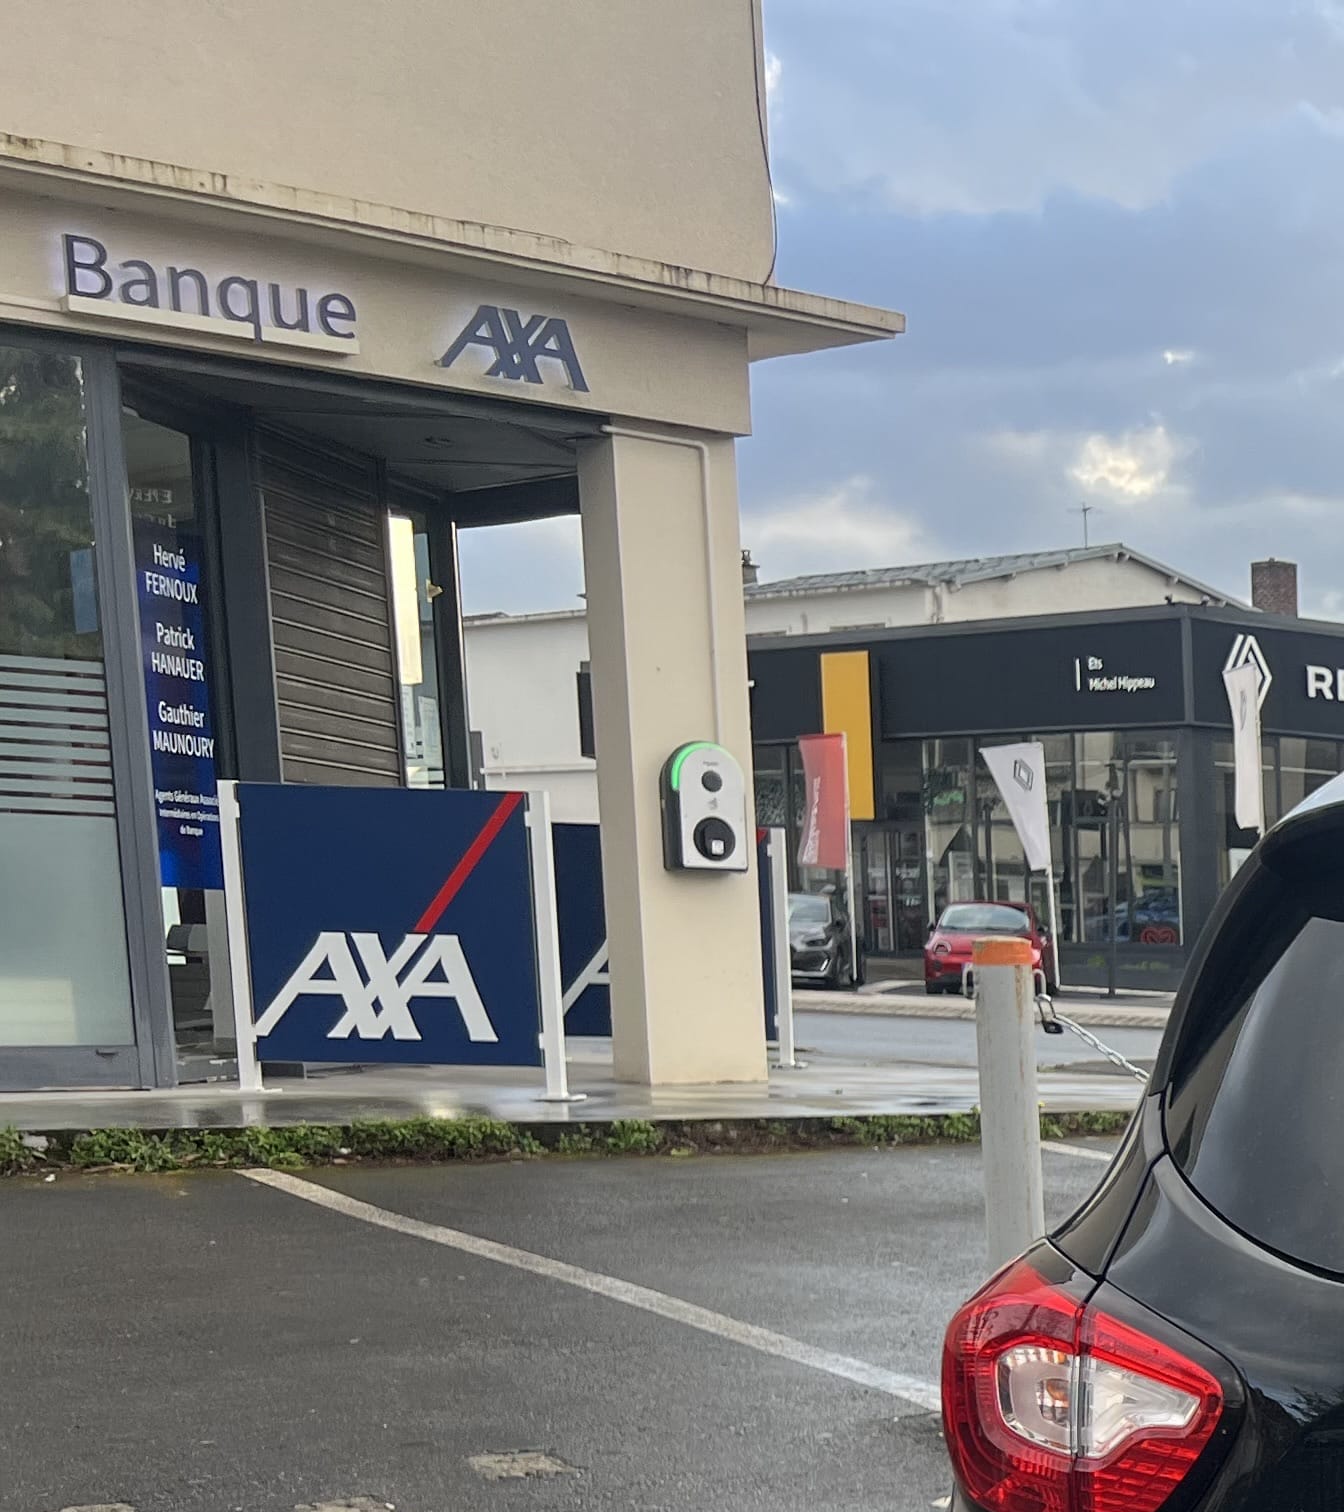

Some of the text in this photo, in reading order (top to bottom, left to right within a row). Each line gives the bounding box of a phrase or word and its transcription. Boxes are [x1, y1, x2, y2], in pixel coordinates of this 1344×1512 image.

[63, 234, 357, 343] Banque
[434, 304, 590, 393] AXA
[153, 543, 186, 572] Hervé
[144, 571, 199, 605] FERNOUX
[155, 622, 195, 650] Patrick
[151, 651, 205, 682] HANAUER
[158, 701, 205, 728] Gauthier
[152, 730, 215, 759] MAUNOURY
[254, 931, 499, 1043] AXA
